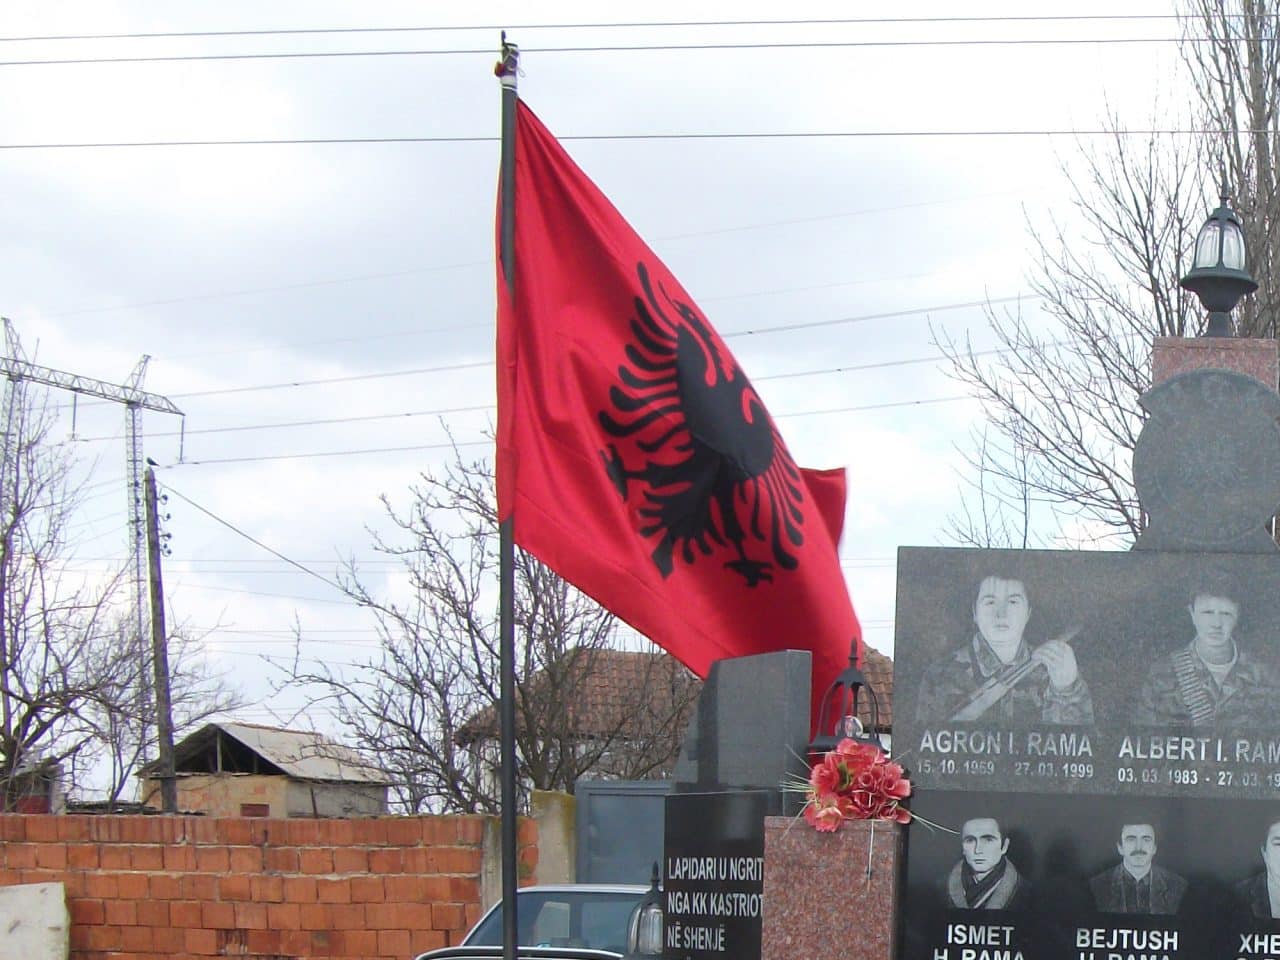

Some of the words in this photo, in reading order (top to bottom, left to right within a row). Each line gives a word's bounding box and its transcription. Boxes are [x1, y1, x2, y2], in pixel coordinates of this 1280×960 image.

[920, 730, 1000, 754] AGRON
[1009, 732, 1018, 754] I.
[1028, 733, 1092, 756] RAMA
[1119, 737, 1210, 760] ALBERT
[1217, 739, 1227, 761] I.
[669, 858, 716, 879] LAPIDARI
[720, 858, 726, 880] U
[730, 858, 763, 881] NGRIT
[668, 892, 690, 914] NGA
[693, 893, 707, 914] KK
[668, 922, 681, 948] NË
[684, 925, 724, 951] SHENJË
[948, 925, 1014, 945] ISMET
[1077, 929, 1177, 950] BEJTUSH
